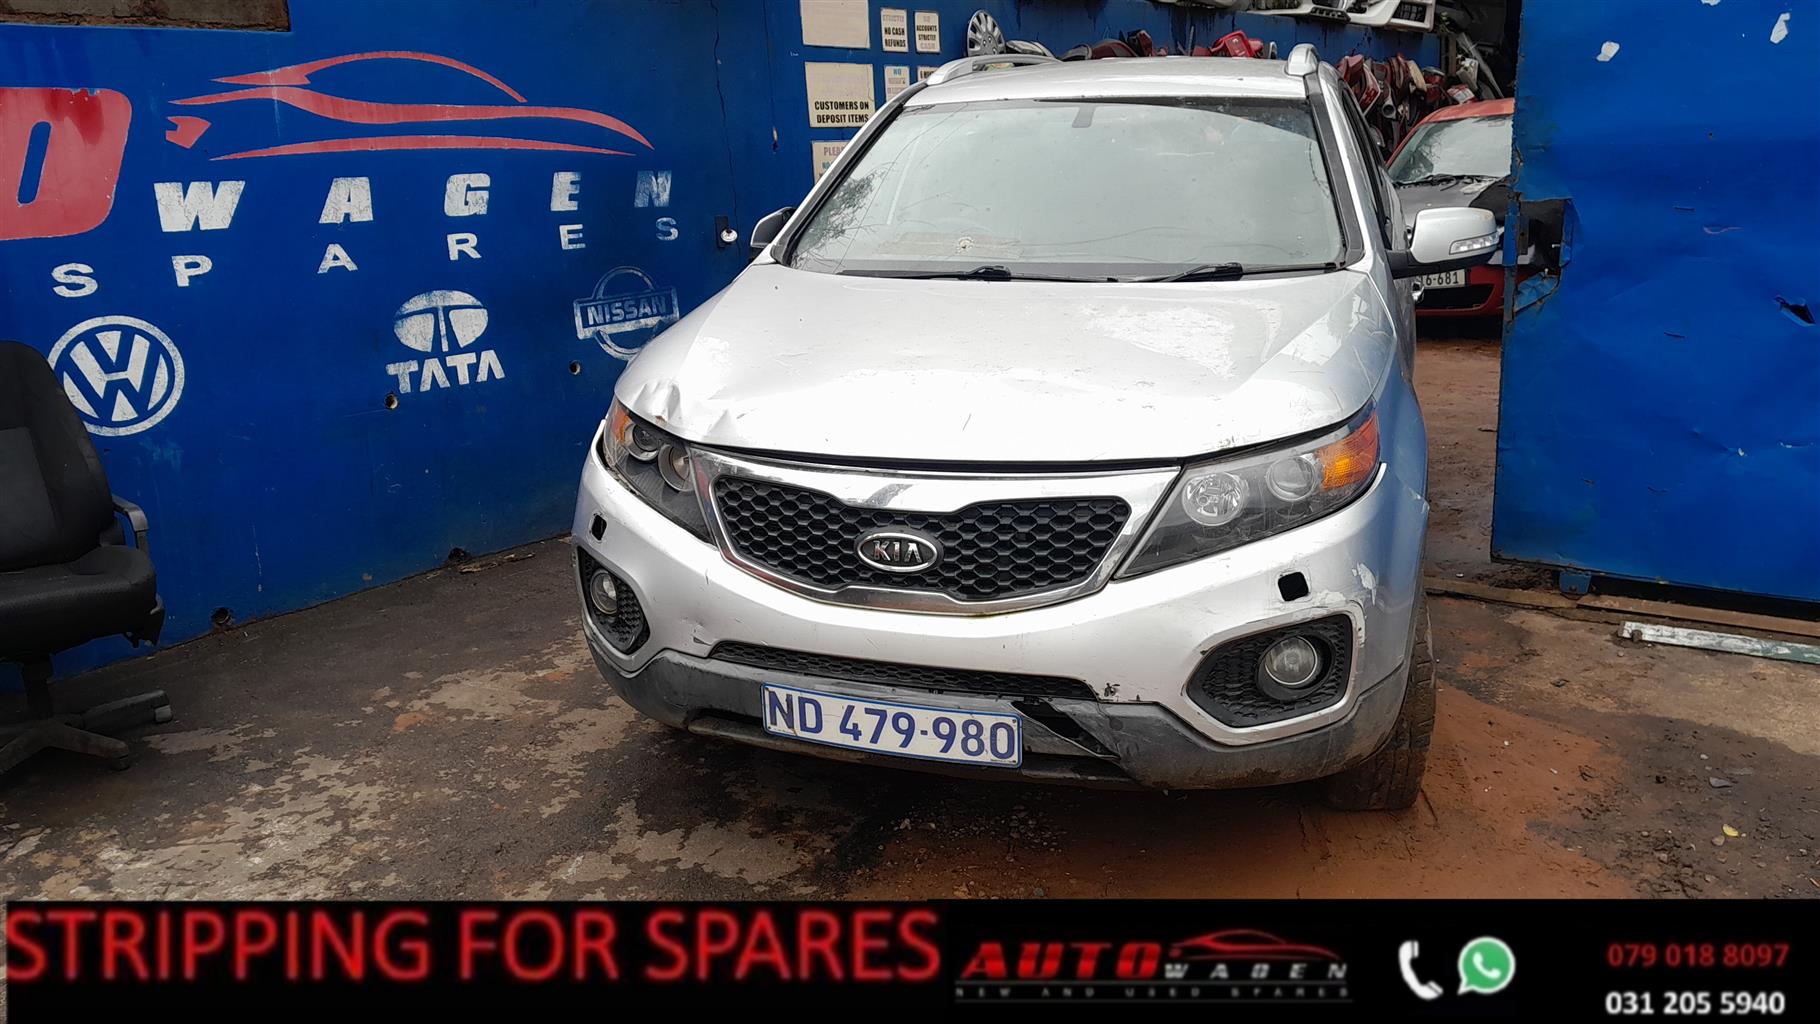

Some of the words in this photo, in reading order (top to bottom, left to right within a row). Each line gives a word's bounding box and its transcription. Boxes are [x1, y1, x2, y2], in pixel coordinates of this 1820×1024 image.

[884, 27, 892, 35] NO
[892, 27, 905, 36] CASH
[885, 39, 906, 47] REFUNDS
[814, 101, 859, 110] CUSTOMERS
[860, 101, 869, 110] ON
[816, 114, 847, 123] DEPOSIT
[848, 113, 869, 123] ITEMS
[153, 170, 673, 233] WAGEN
[51, 216, 680, 299] SPARES
[587, 296, 667, 325] NISSAN
[385, 349, 505, 394] TATA
[873, 541, 922, 563] KIA
[767, 690, 823, 734] ND
[839, 705, 1015, 759] 479-980
